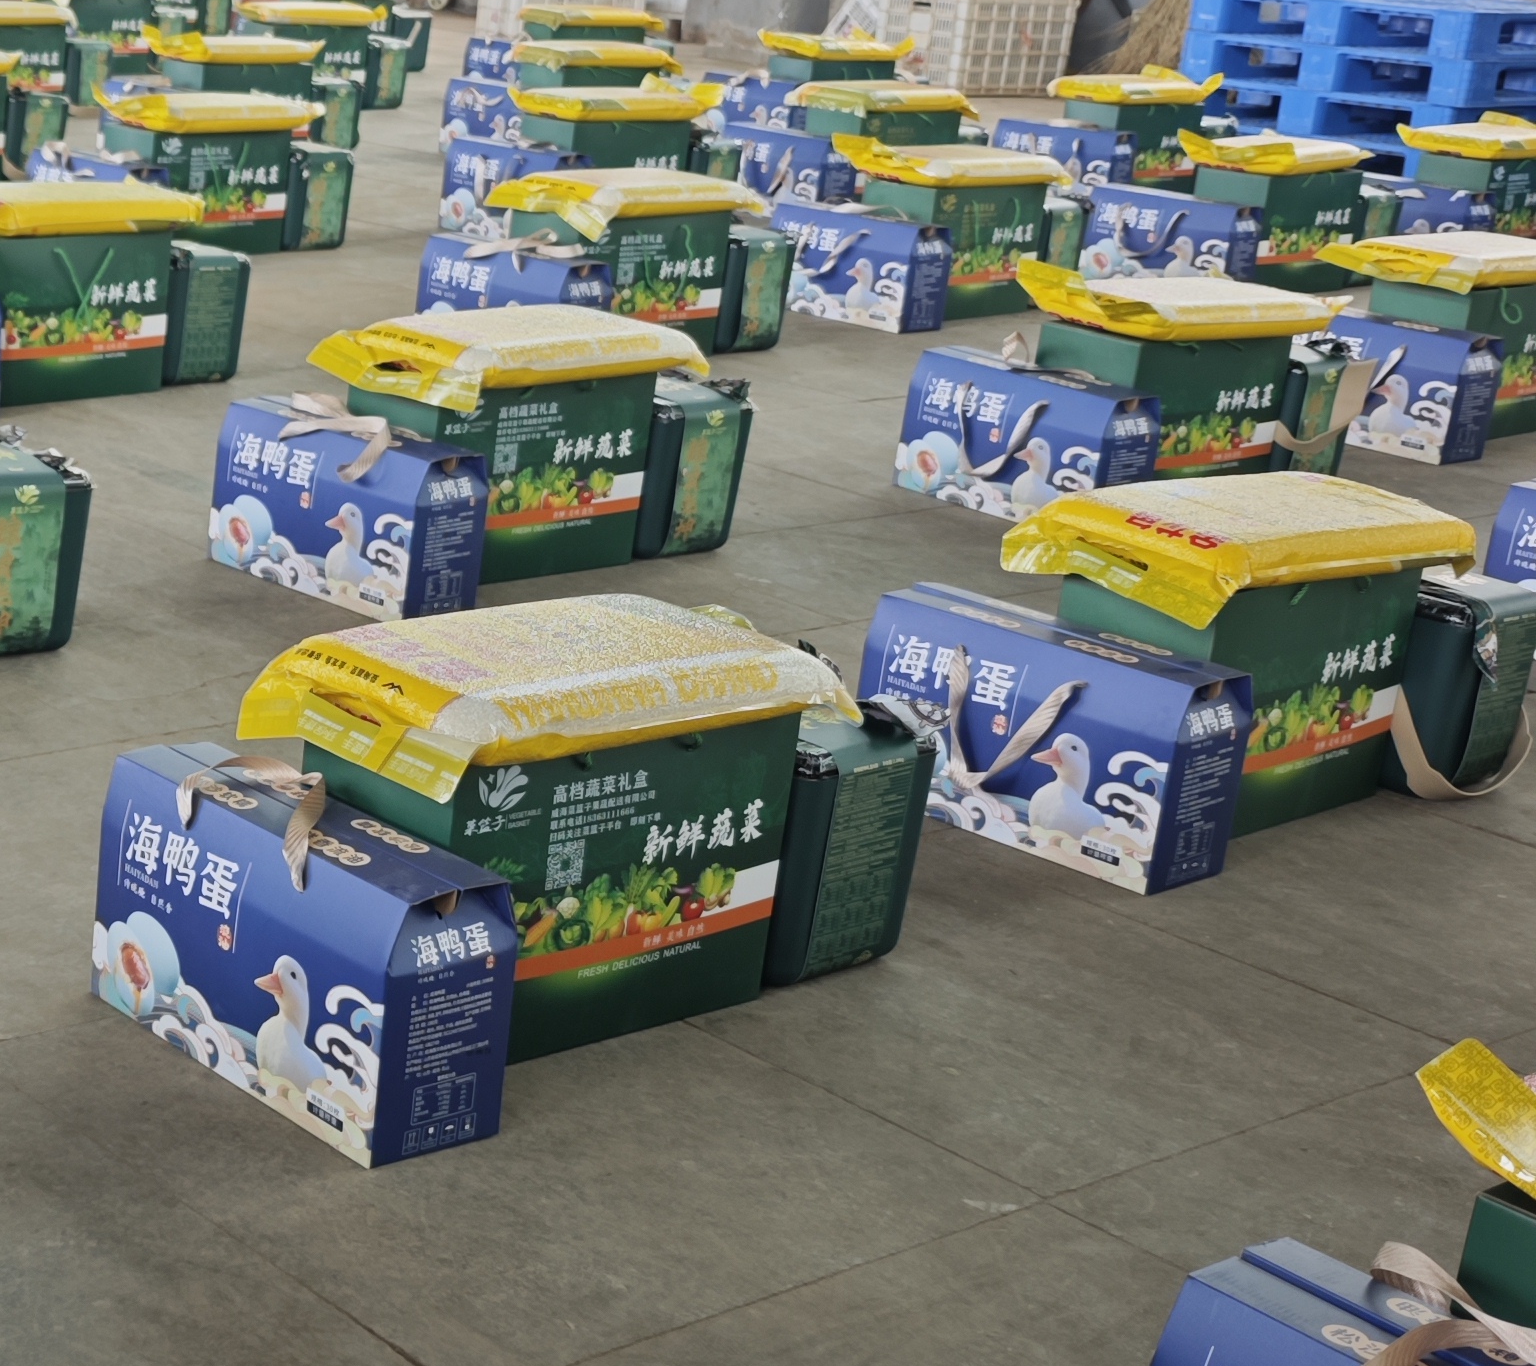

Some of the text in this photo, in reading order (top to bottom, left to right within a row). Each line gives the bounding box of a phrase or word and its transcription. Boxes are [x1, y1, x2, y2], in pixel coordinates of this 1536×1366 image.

[228, 162, 280, 184] 新鲜蔬菜
[430, 256, 490, 294] 海鸭蛋
[660, 256, 716, 280] 新鲜蔬菜
[91, 278, 158, 305] 新鲜蔬菜
[1216, 383, 1274, 413] 新鲜蔬菜
[233, 432, 315, 488] 海鸭蛋
[553, 428, 633, 465] 新鲜蔬菜
[427, 476, 473, 502] 海鸭蛋
[1320, 632, 1397, 685] 新鲜蔬菜
[1185, 701, 1235, 737] 海鸭蛋
[553, 769, 649, 805] 高档蔬菜礼盒
[640, 797, 764, 866] 新鲜蔬菜
[124, 863, 159, 890] HAIYADAN
[125, 812, 240, 920] 海鸭蛋
[410, 921, 492, 968] 海鸭蛋
[577, 940, 701, 980] FRESH DELICIOUS NATURAL
